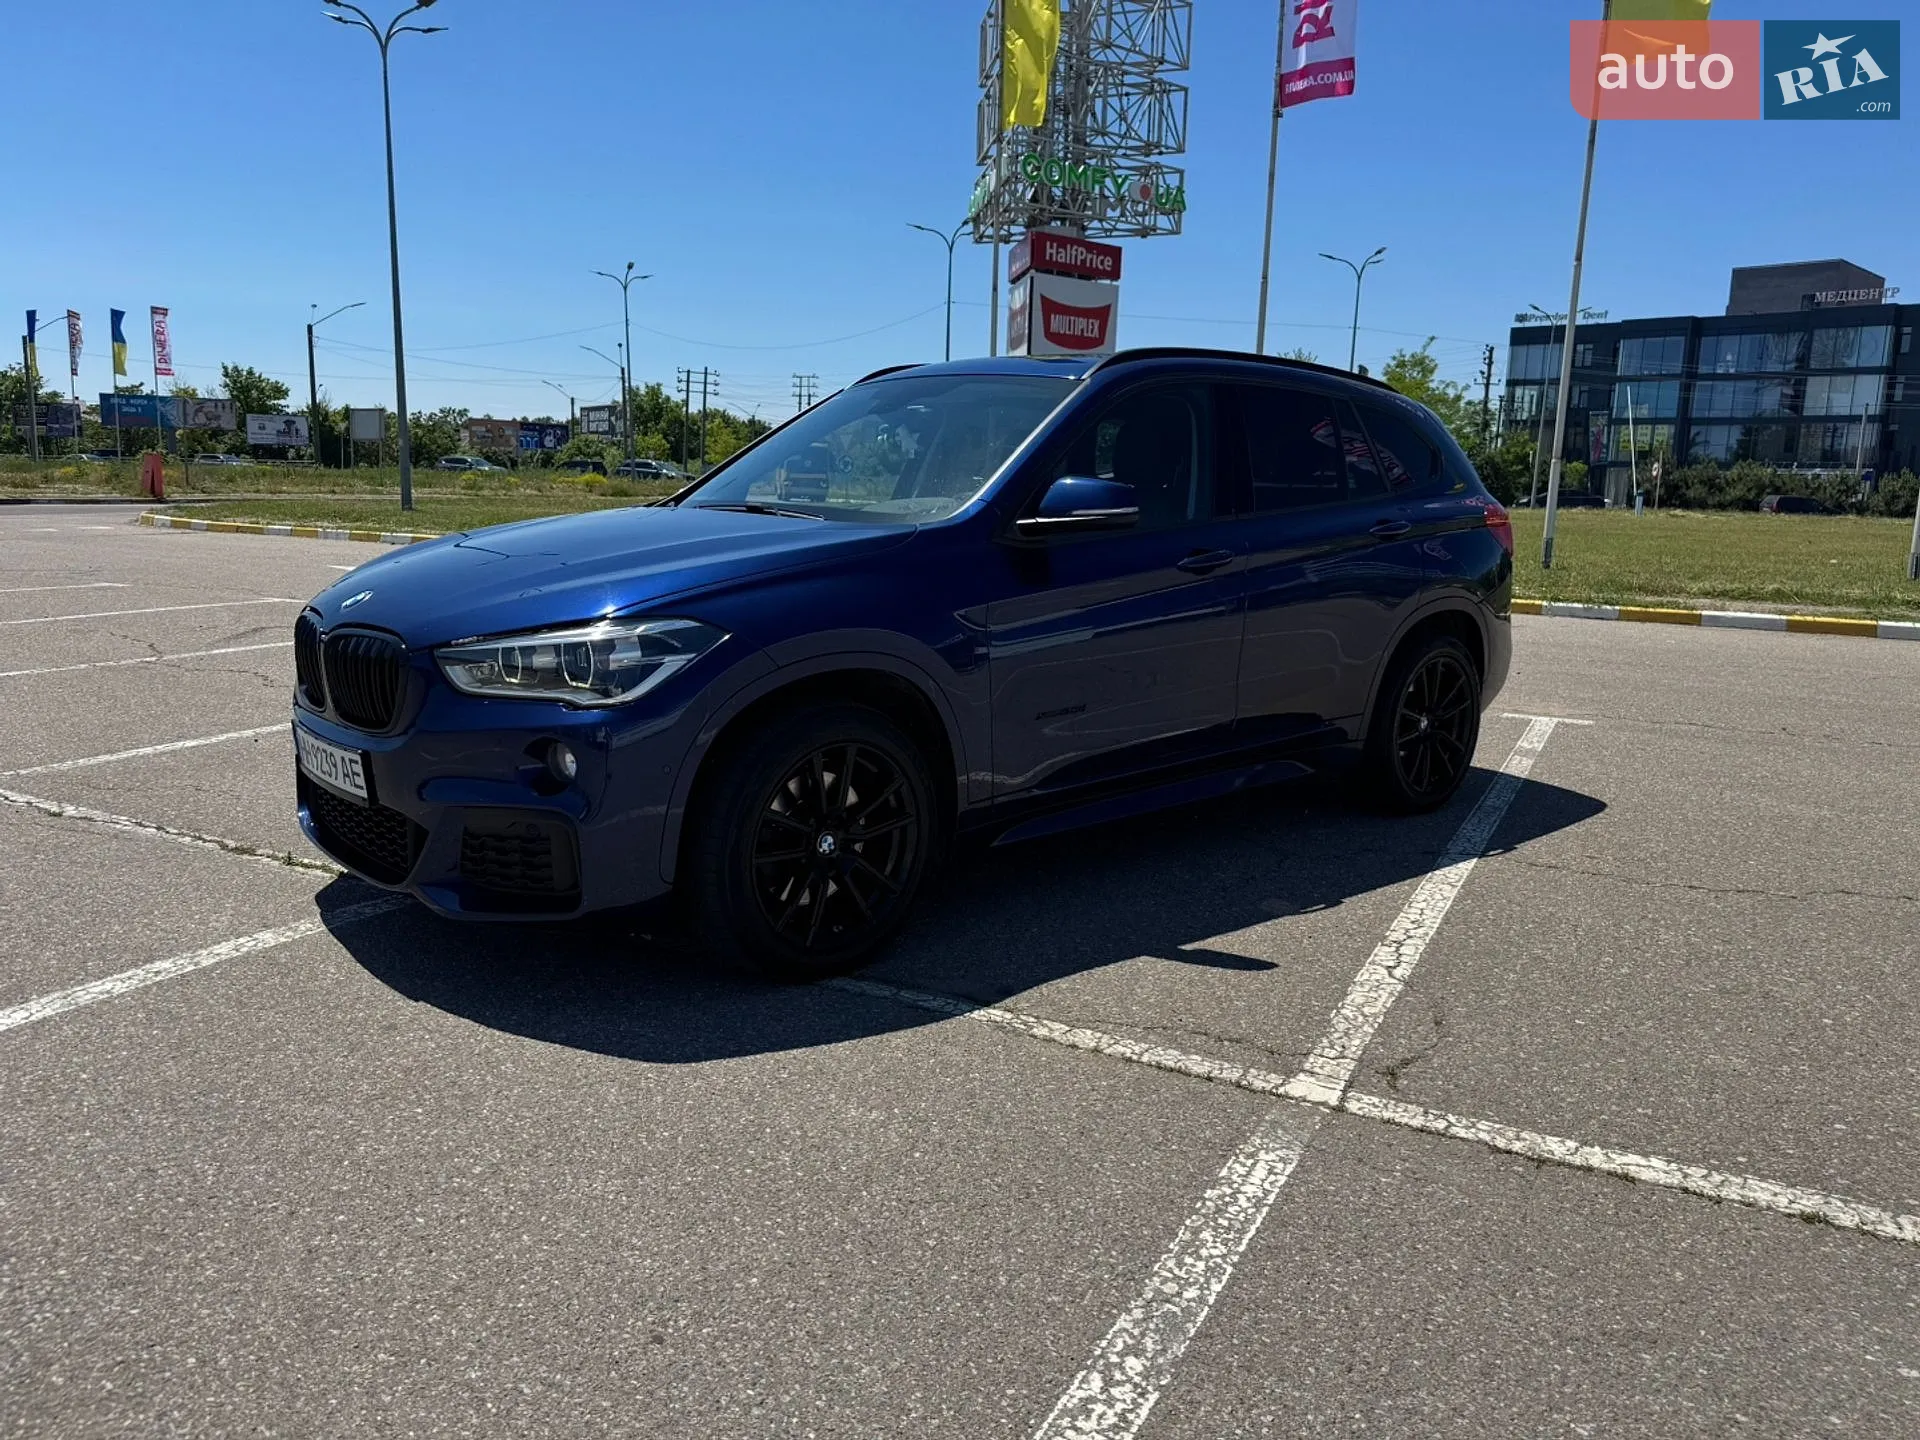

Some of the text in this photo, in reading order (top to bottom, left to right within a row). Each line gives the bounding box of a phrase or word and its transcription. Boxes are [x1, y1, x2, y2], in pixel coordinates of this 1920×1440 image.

[1045, 240, 1113, 271] HalfPrice
[1050, 312, 1100, 338] MULTIPLEX
[341, 755, 365, 790] AE
